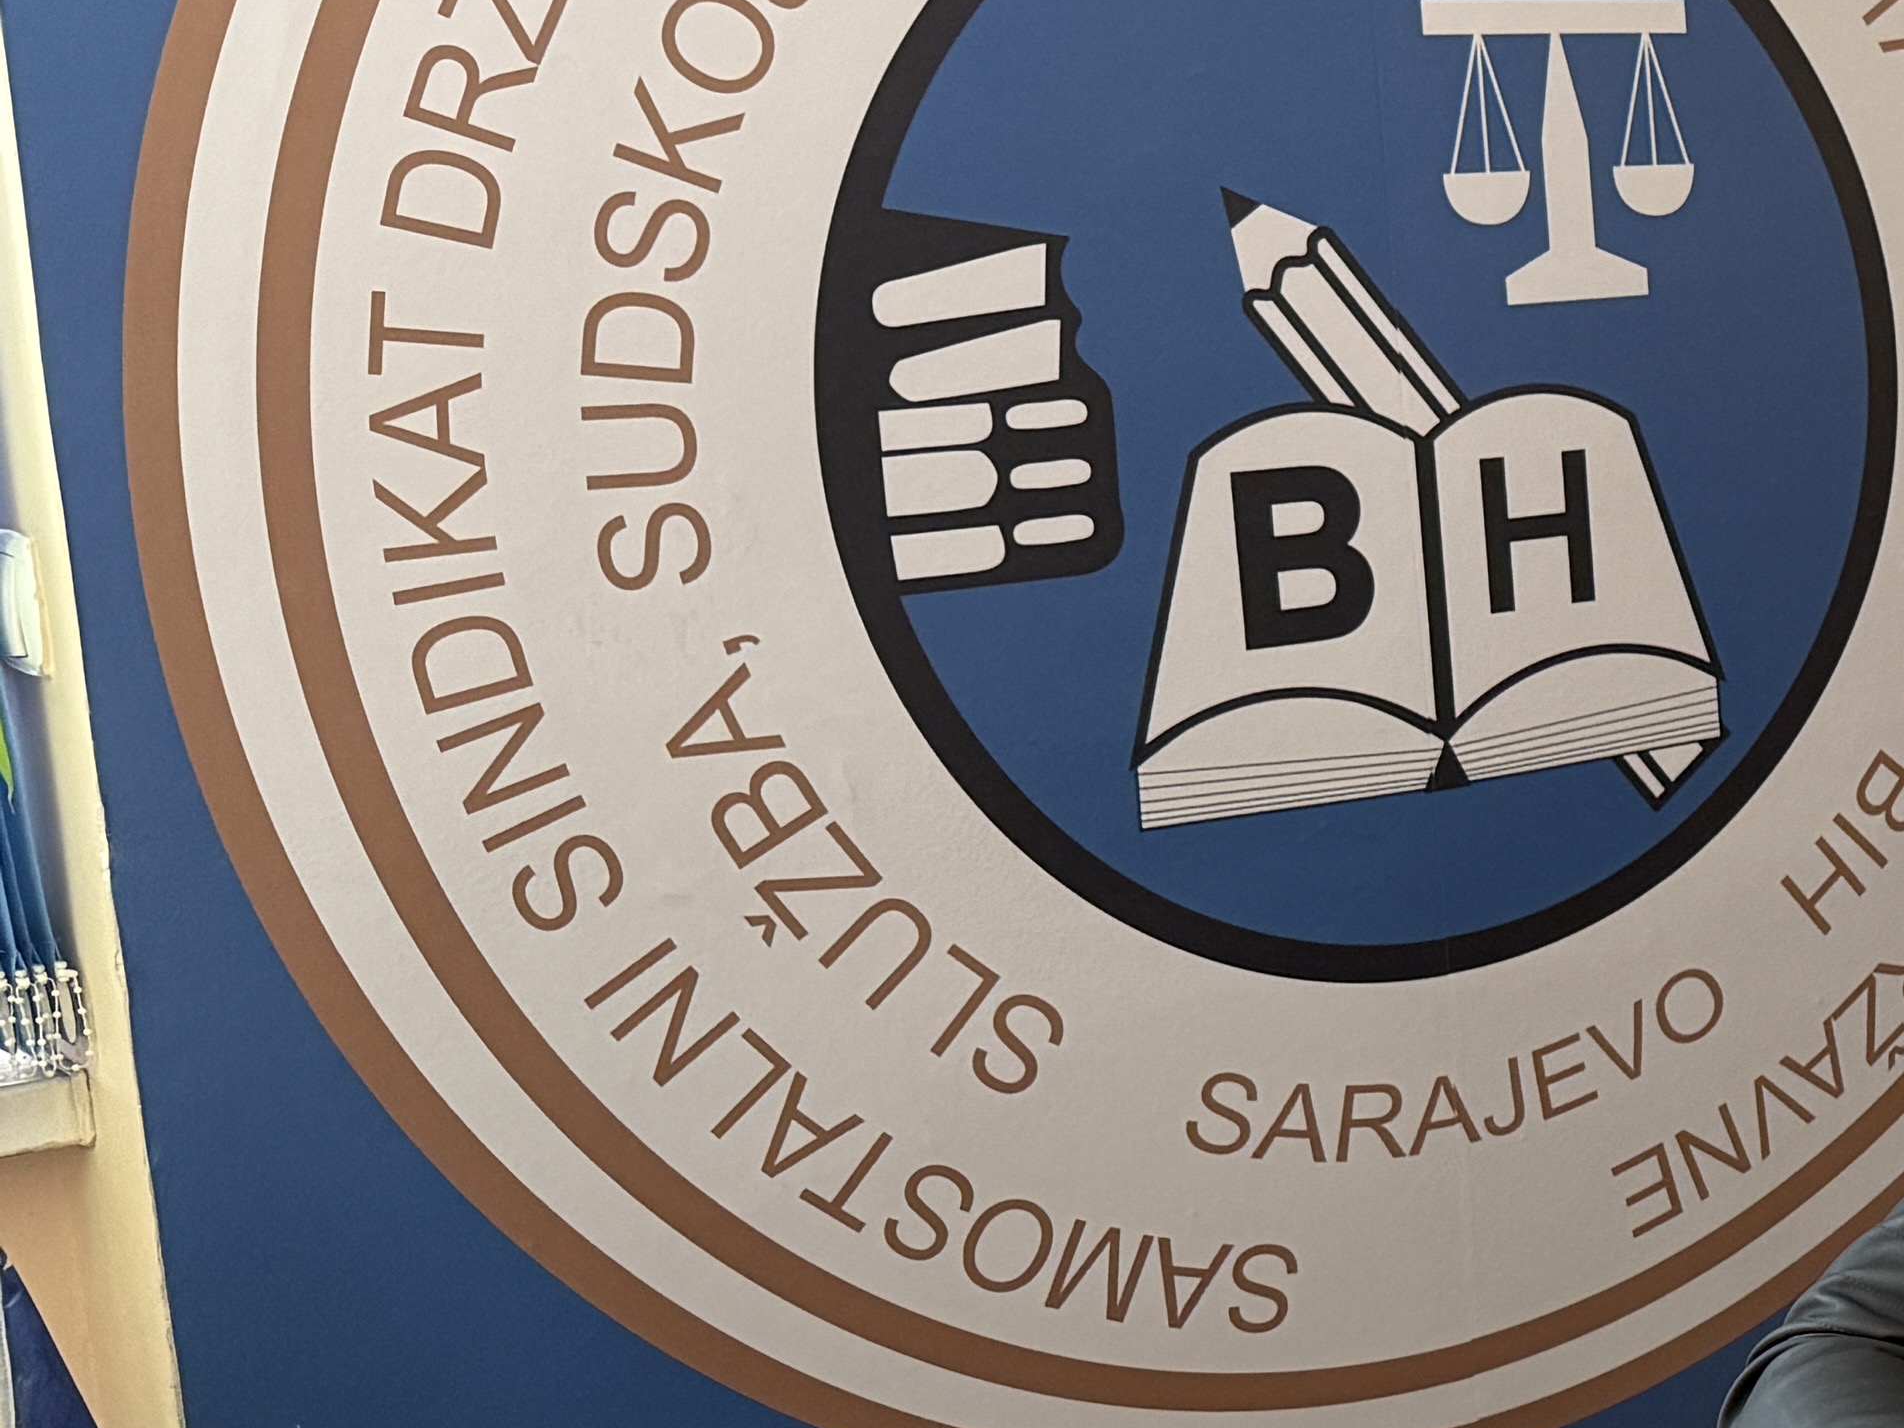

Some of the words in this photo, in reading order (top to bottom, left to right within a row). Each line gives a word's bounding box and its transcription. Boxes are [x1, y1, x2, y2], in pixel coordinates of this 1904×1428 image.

[366, 289, 624, 931] SINDIKAT
[1225, 462, 1378, 653] B
[1489, 448, 1598, 608] H
[707, 633, 1068, 1102] SLUŽBA,
[1184, 965, 1726, 1167] SARAJEVO
[587, 934, 1298, 1336] SAMOSTALNI
